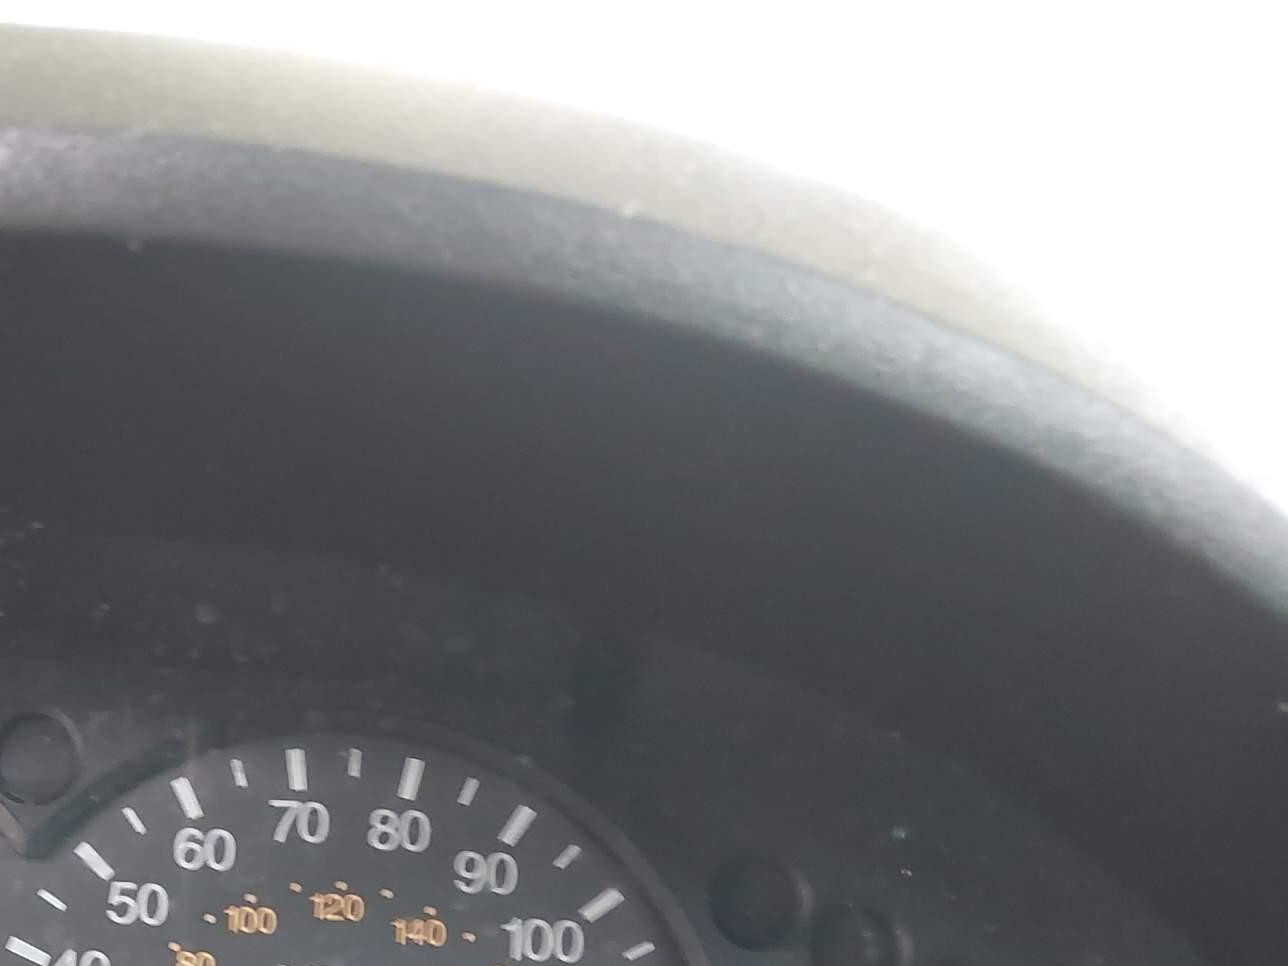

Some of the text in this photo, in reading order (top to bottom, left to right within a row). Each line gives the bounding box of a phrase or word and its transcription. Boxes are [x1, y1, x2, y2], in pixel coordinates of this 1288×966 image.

[269, 800, 330, 844] 70
[366, 810, 432, 852] 80
[172, 828, 236, 872] 60
[453, 852, 517, 896] 90
[106, 882, 169, 926] 50
[224, 905, 276, 933] 100
[309, 892, 363, 921] 120
[390, 917, 445, 946] 140
[500, 917, 582, 962] 100
